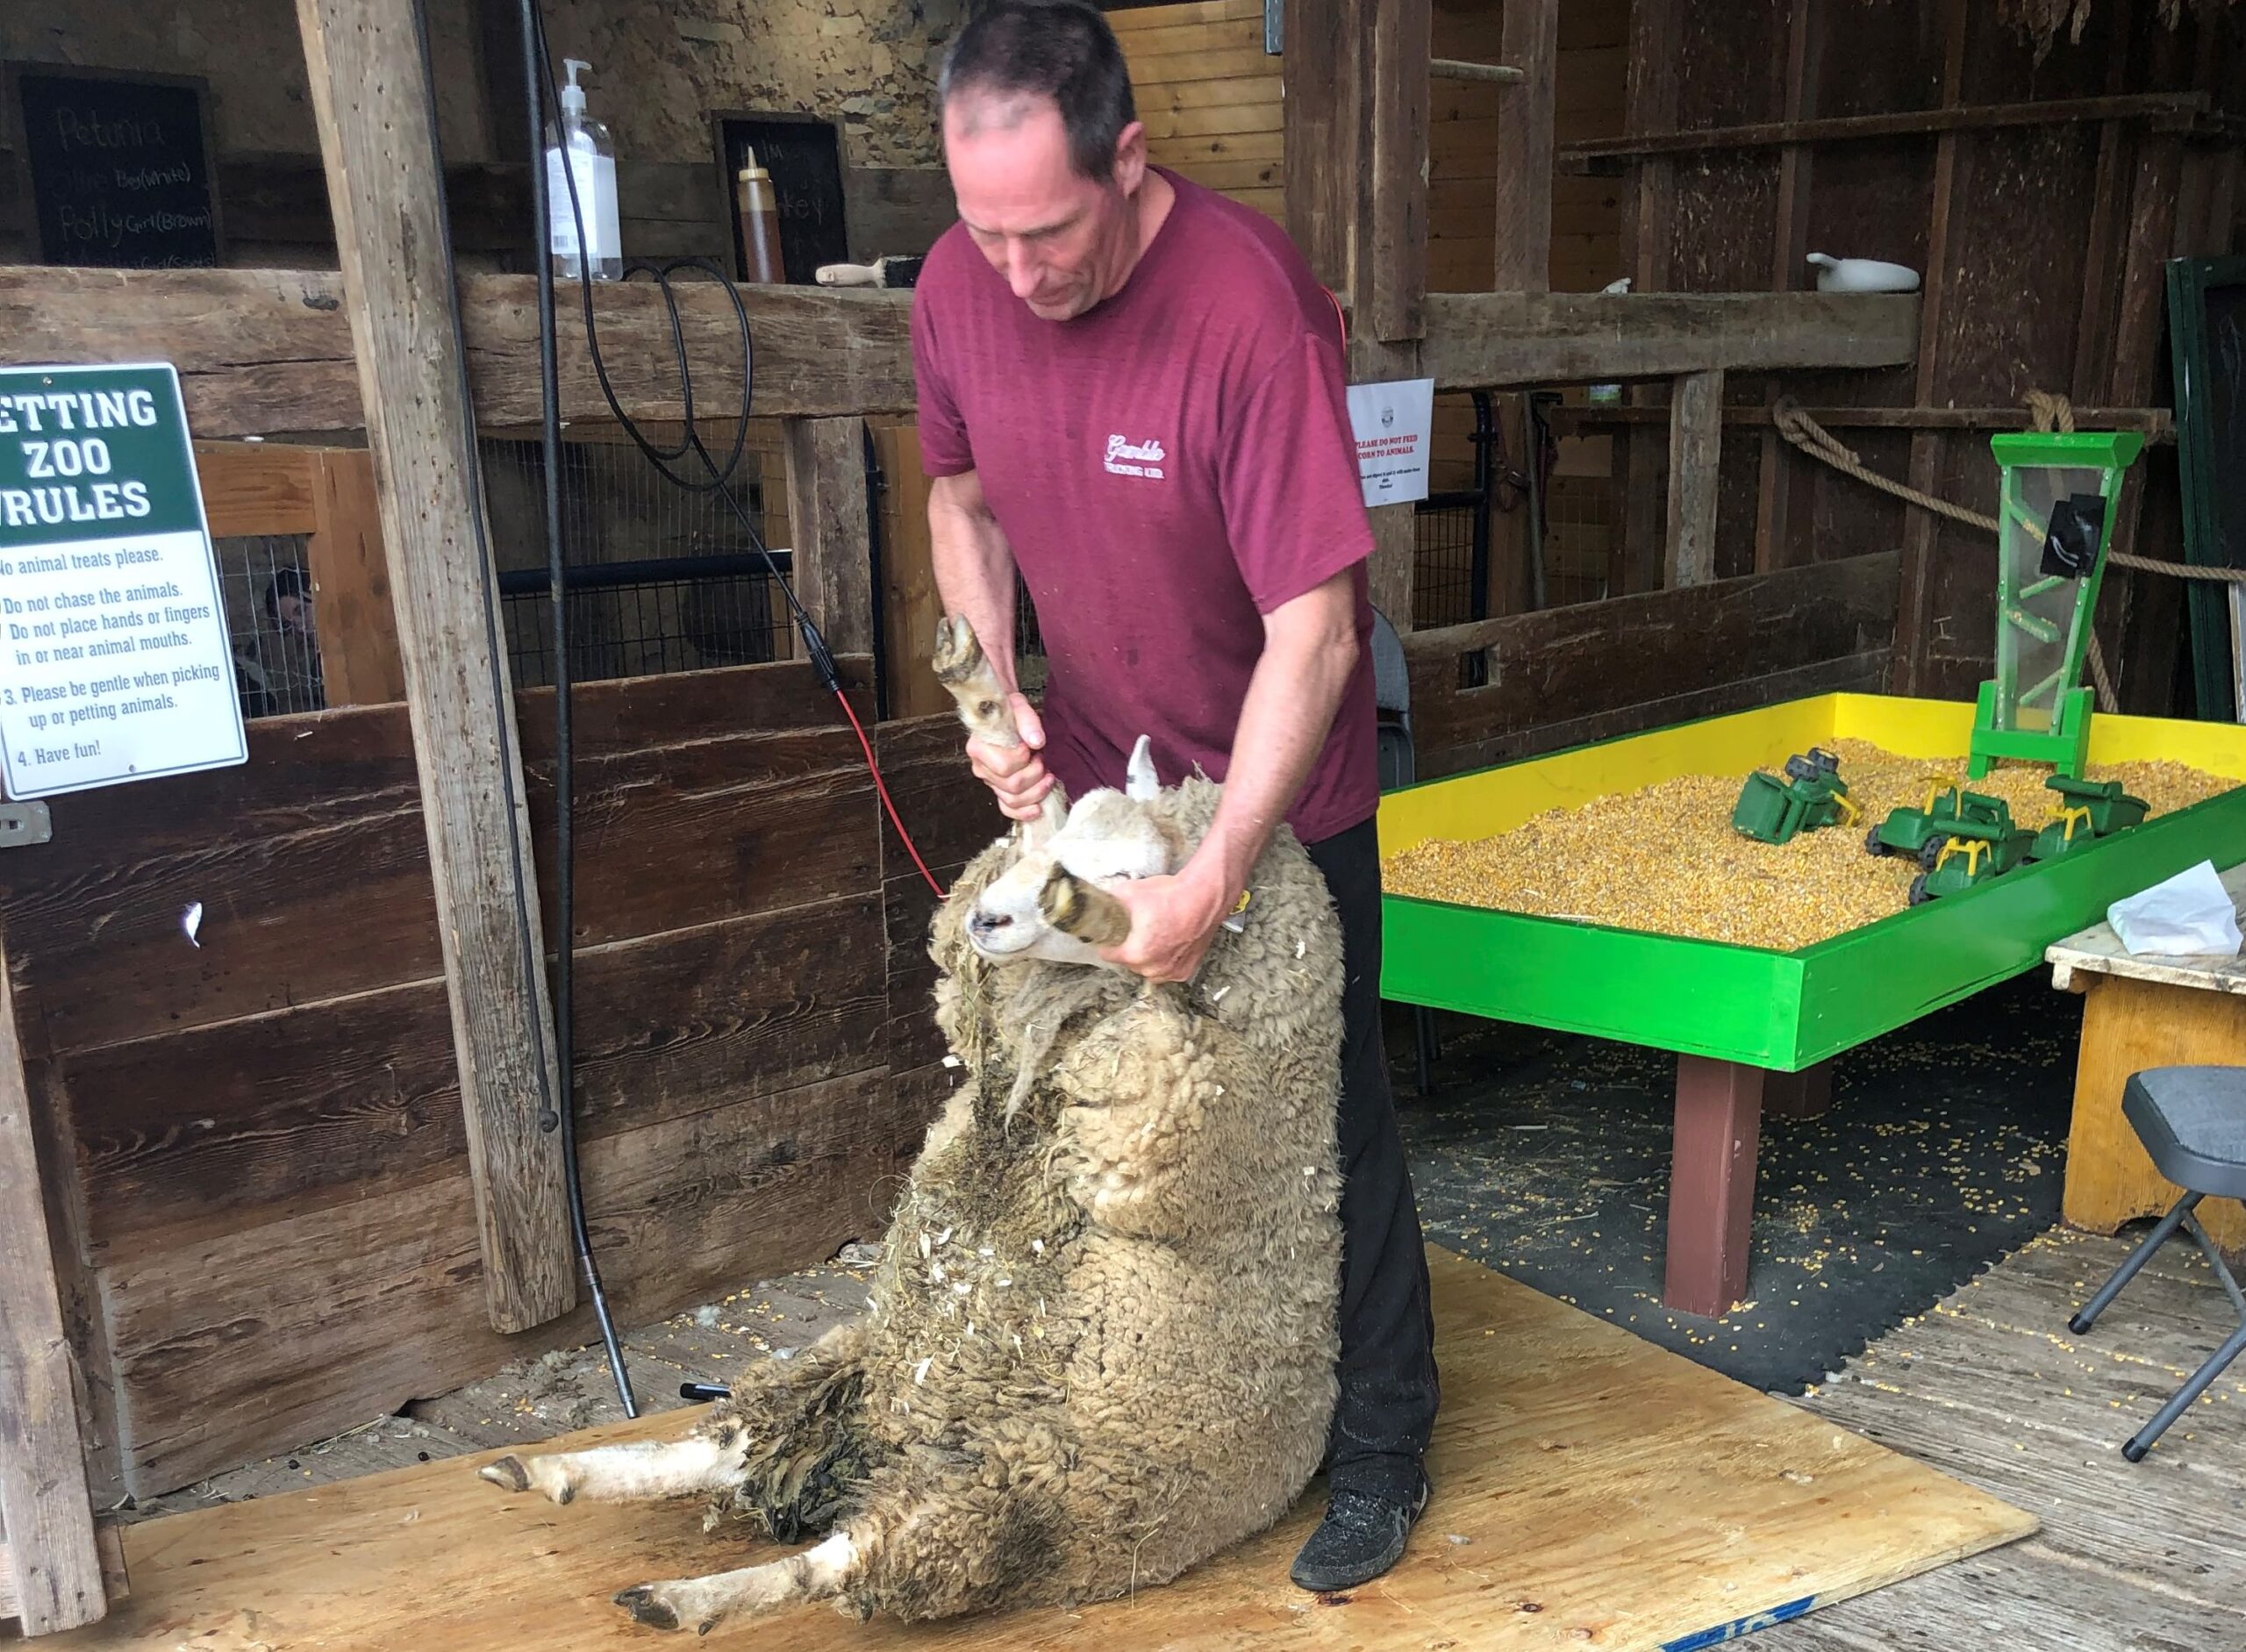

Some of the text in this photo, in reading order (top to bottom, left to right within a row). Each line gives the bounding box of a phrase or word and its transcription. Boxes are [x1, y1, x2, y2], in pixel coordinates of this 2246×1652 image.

[56, 106, 165, 151] Petunia
[22, 438, 111, 478] ZOO
[1358, 451, 1376, 460] CORN
[2, 482, 151, 526] RULES
[18, 554, 68, 574] animal
[71, 552, 111, 569] treats
[115, 548, 163, 569] please.
[3, 582, 182, 614] Do not chase the animals.
[10, 605, 210, 640] Do not place hands or fingers
[16, 631, 192, 665] in or near animal mouths.
[4, 664, 220, 705] 3. Please be gentle when picking
[29, 693, 178, 731] up or petting animals.
[18, 740, 102, 767] 4. Have fun!
